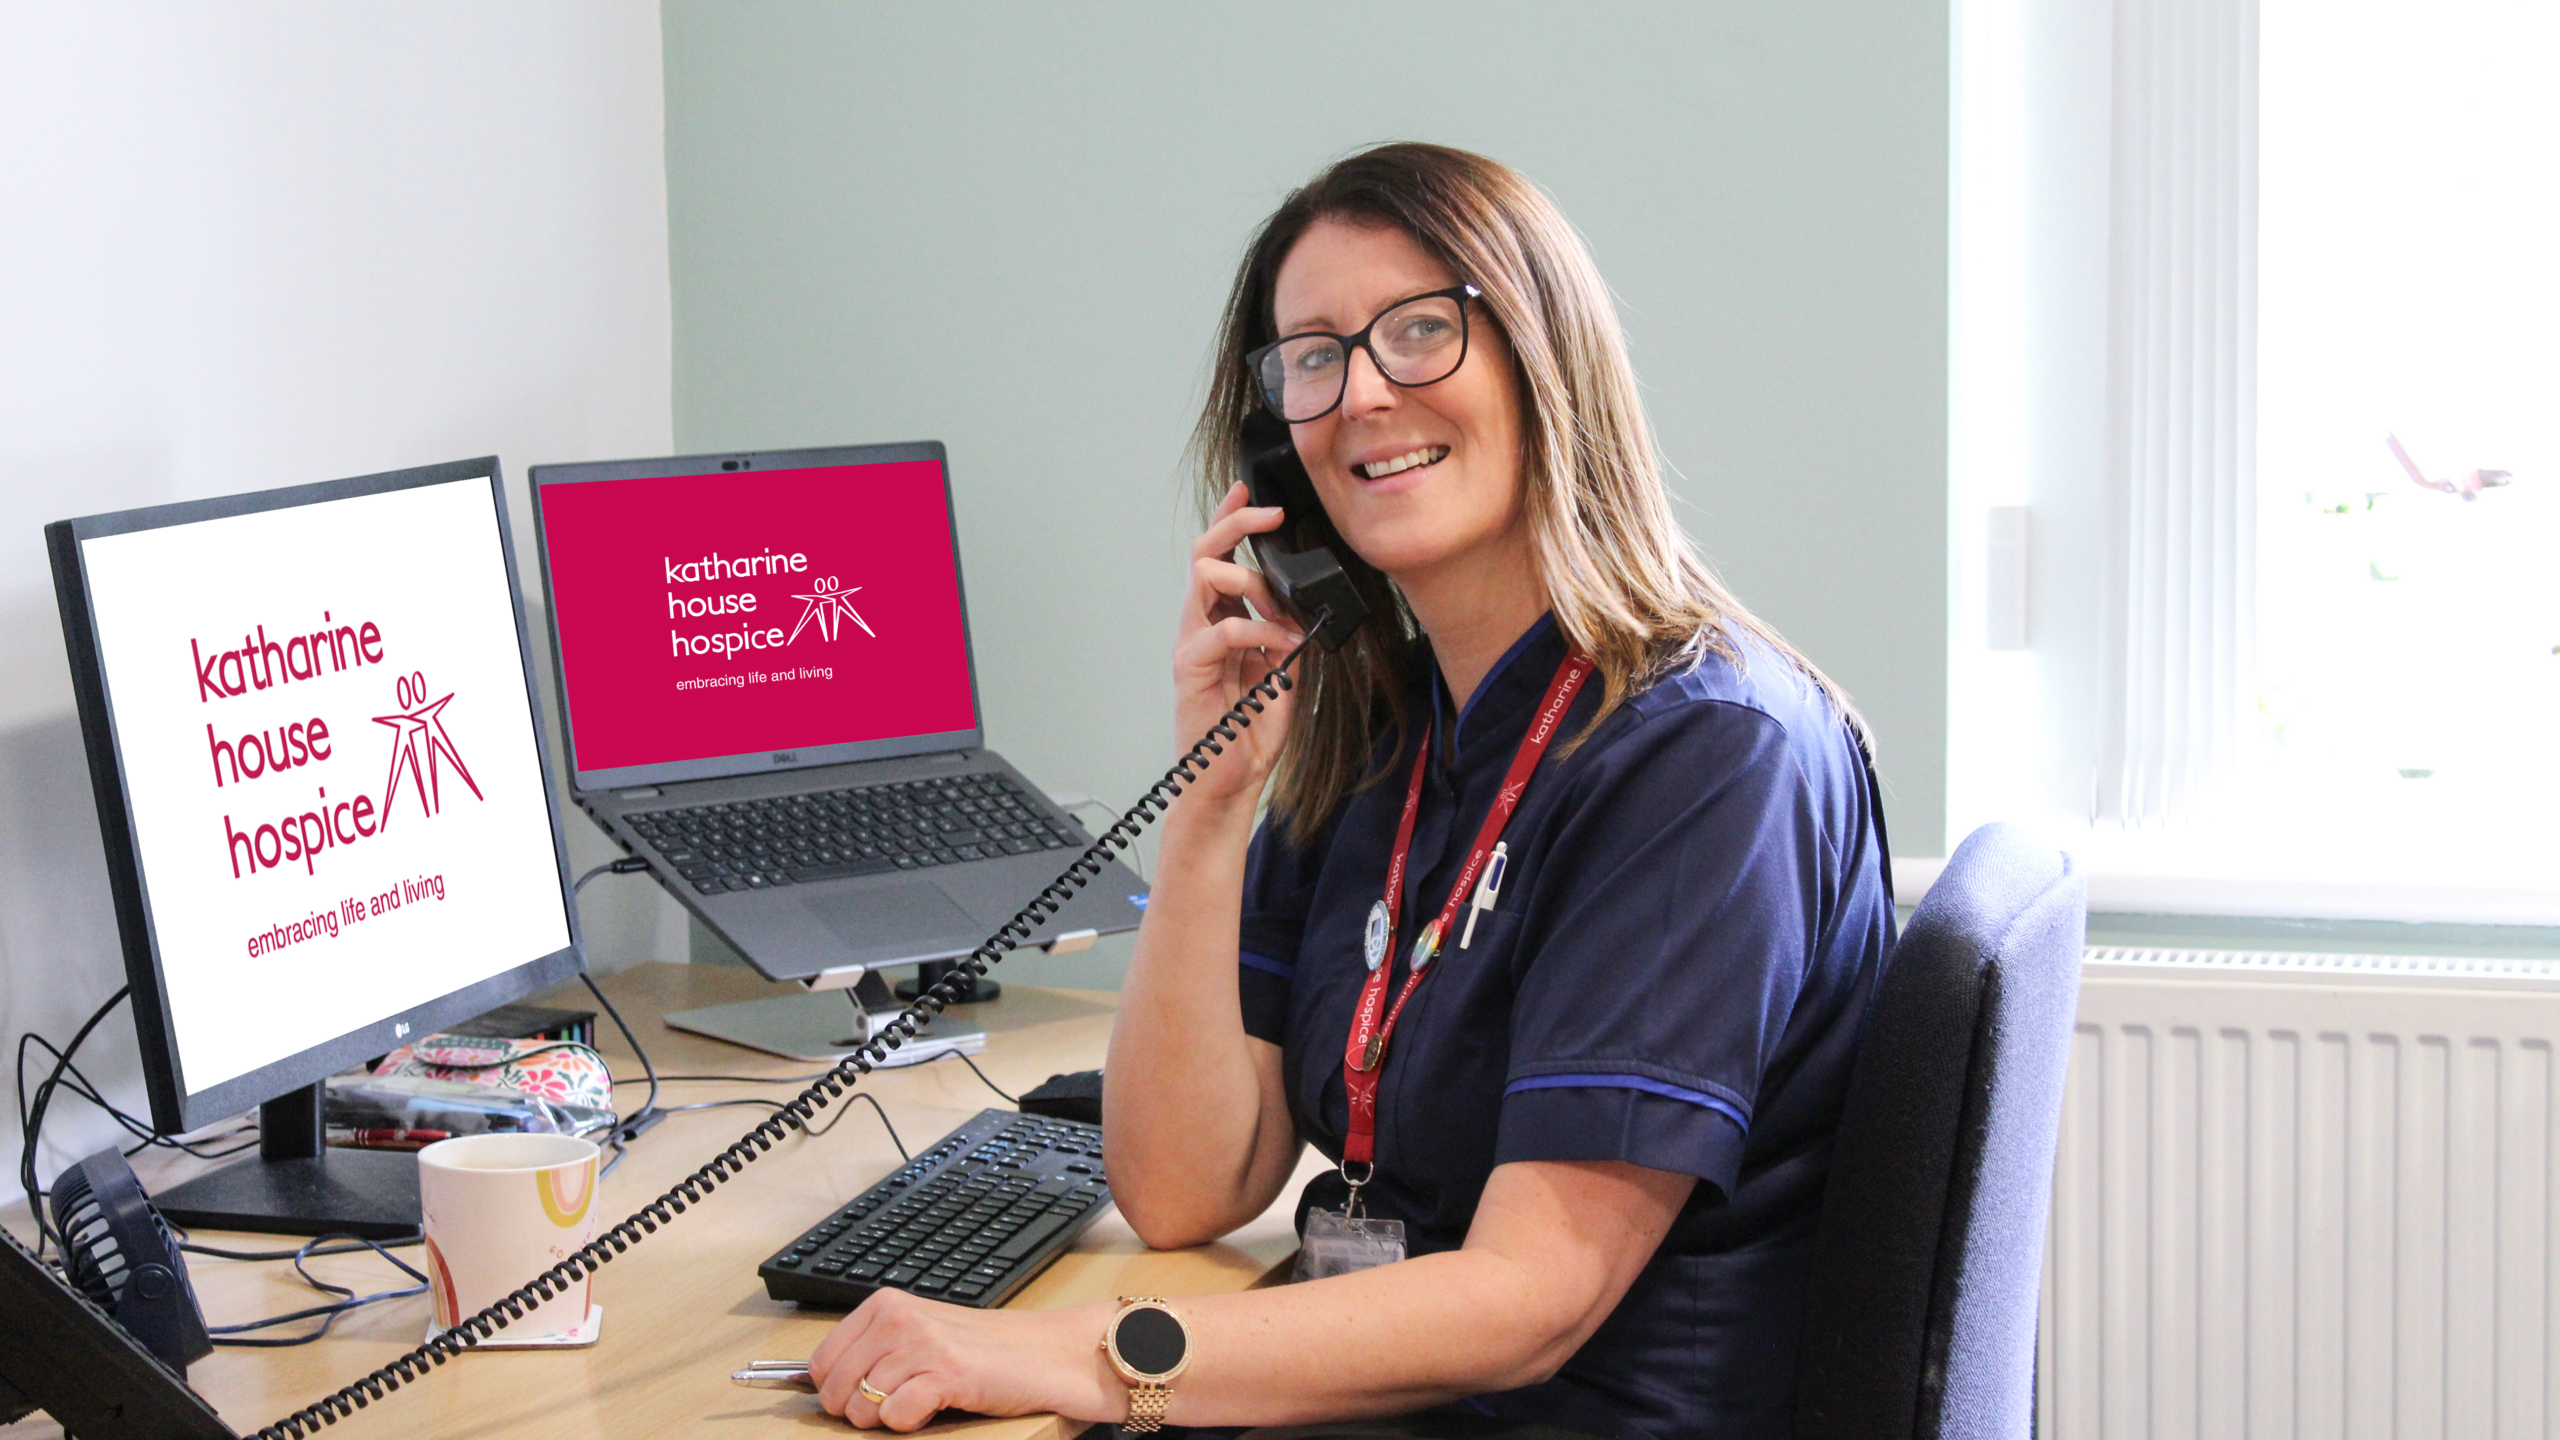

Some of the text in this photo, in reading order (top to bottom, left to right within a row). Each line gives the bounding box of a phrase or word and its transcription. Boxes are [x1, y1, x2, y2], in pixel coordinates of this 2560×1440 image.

[664, 547, 808, 584] katharine
[667, 591, 757, 619] house
[190, 611, 384, 703] katharine
[671, 622, 785, 661] hospice
[676, 667, 833, 691] embracing life and living
[1530, 669, 1581, 744] katharine
[206, 717, 332, 788] house
[223, 786, 377, 879] hospice
[1386, 852, 1404, 910] kathari
[1448, 849, 1483, 907] hospice
[247, 874, 445, 959] embracing life and living
[1358, 987, 1381, 1044] hospice
